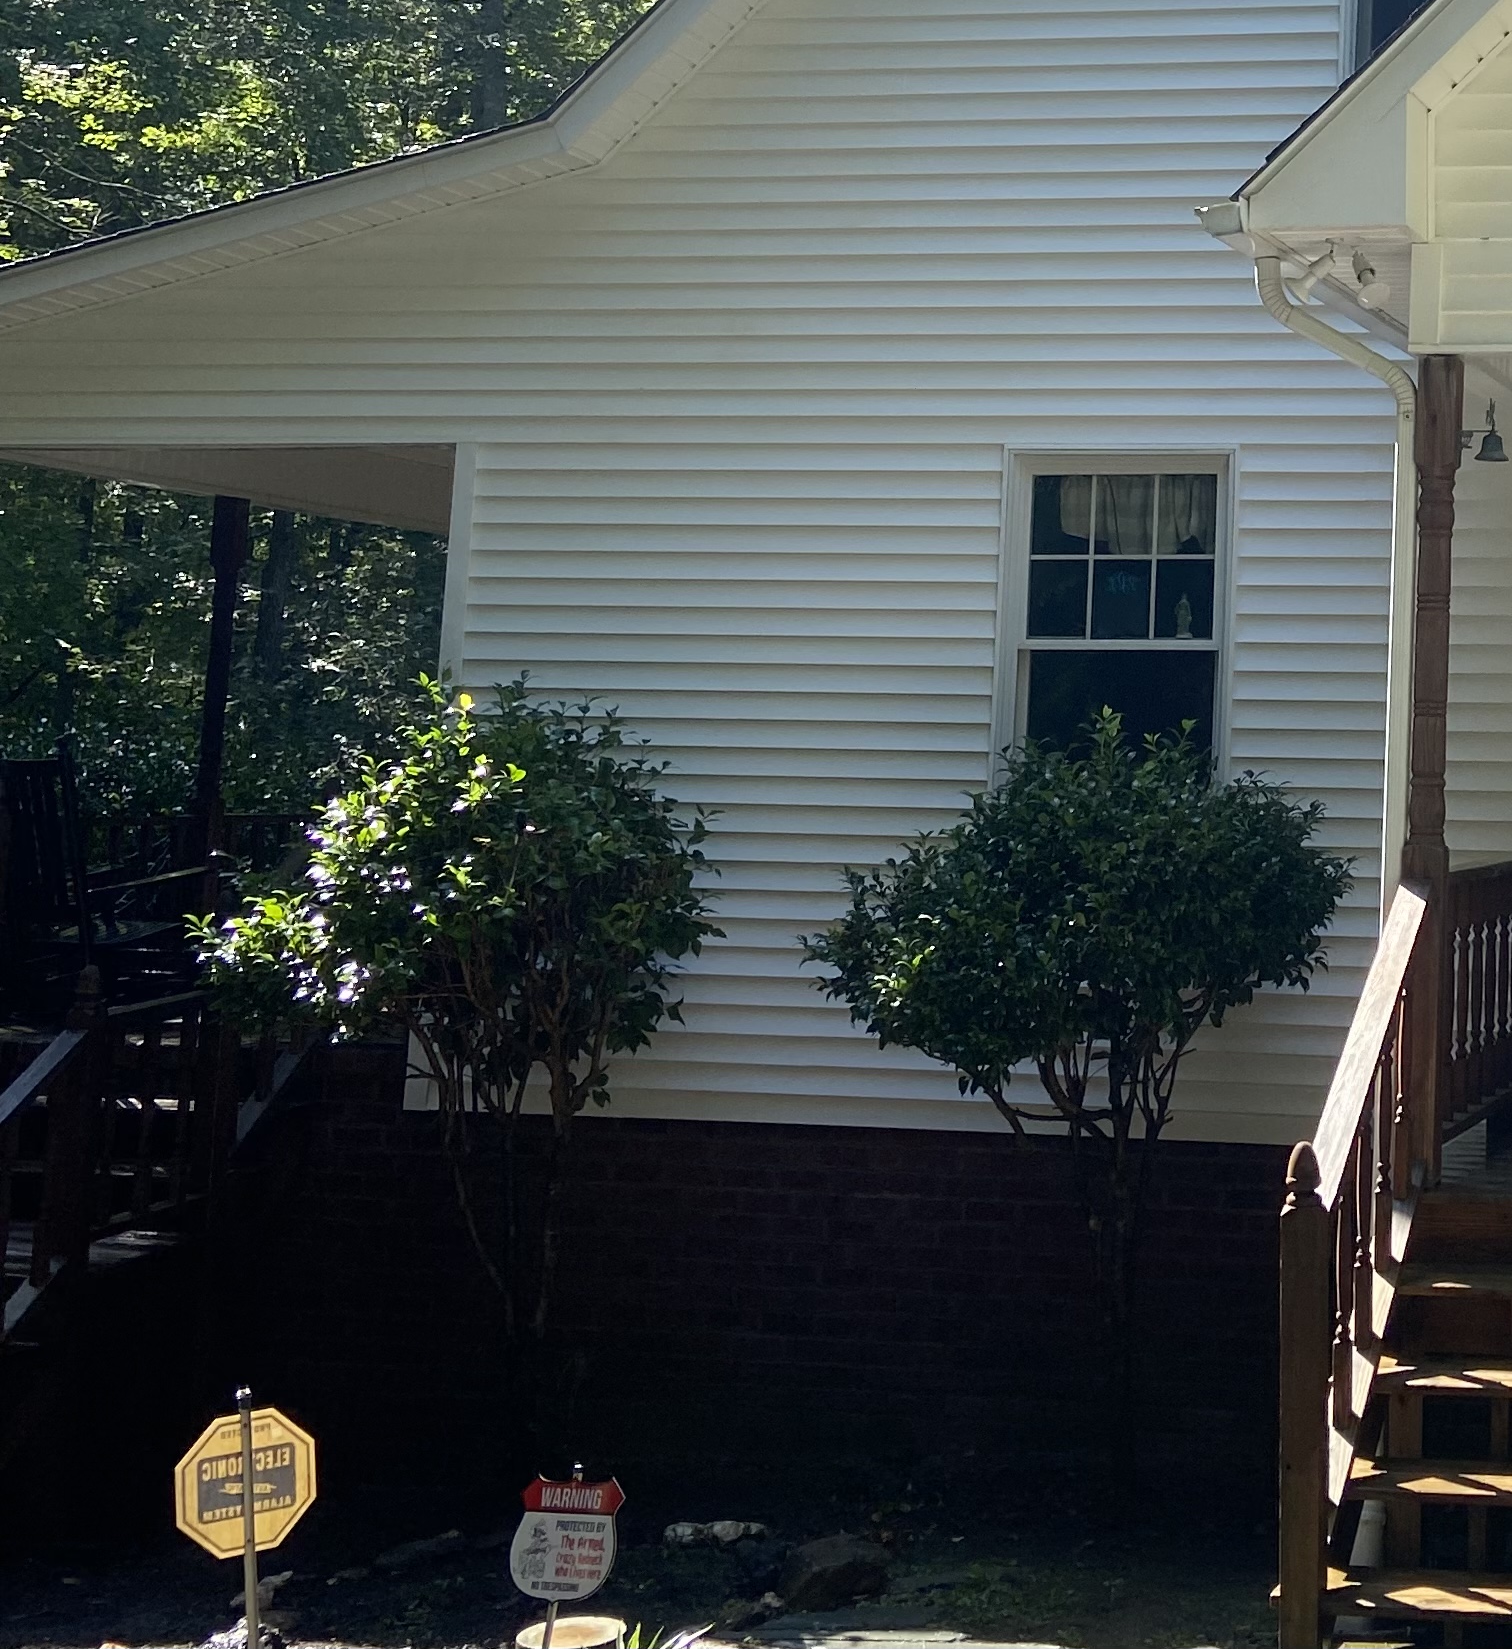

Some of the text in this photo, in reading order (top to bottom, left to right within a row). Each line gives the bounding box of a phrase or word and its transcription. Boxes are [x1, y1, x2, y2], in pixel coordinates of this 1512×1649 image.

[541, 1486, 603, 1509] WARNING
[555, 1521, 606, 1532] PROTECTED BY
[561, 1535, 574, 1550] The
